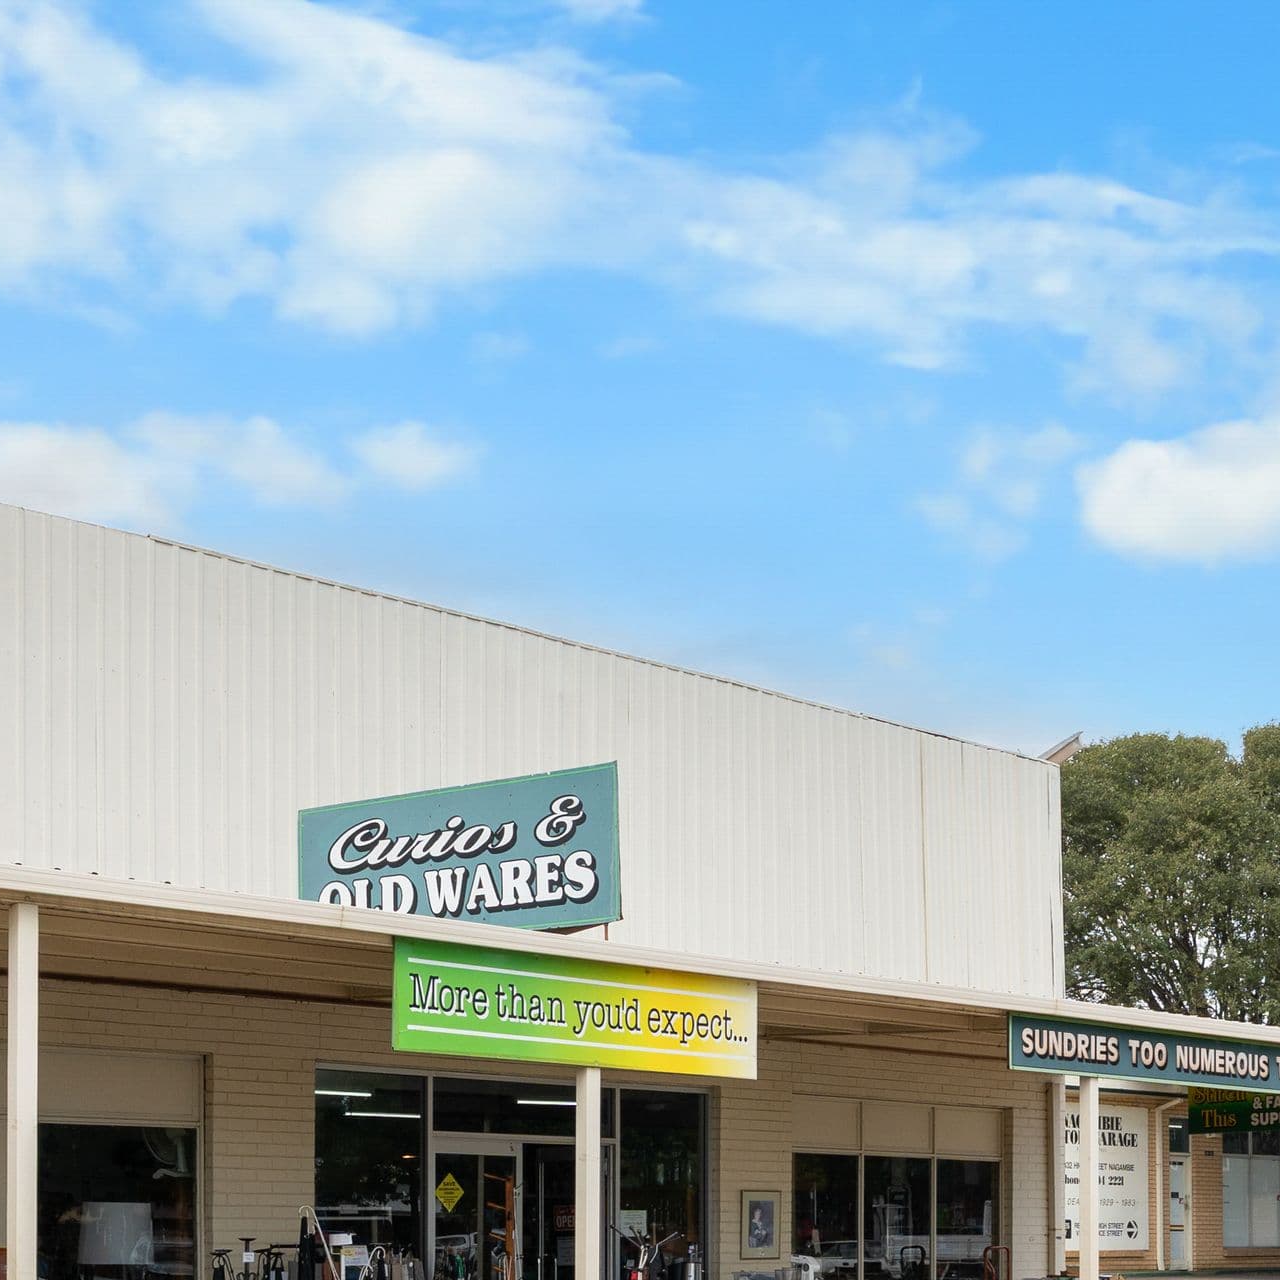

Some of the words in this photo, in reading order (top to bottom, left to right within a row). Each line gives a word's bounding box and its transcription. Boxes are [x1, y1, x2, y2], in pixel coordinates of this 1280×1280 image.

[328, 816, 517, 874] Curios
[534, 795, 584, 847] &
[319, 874, 415, 916] OLD
[424, 850, 597, 914] WARES
[408, 973, 488, 1018] More
[494, 984, 566, 1026] than
[573, 995, 641, 1037] you'd
[647, 1006, 749, 1046] expect...
[1022, 1027, 1119, 1064] SUNDRIES
[1128, 1040, 1167, 1068] TOO
[1176, 1045, 1269, 1080] NUMEROUS
[1202, 1109, 1237, 1128] This
